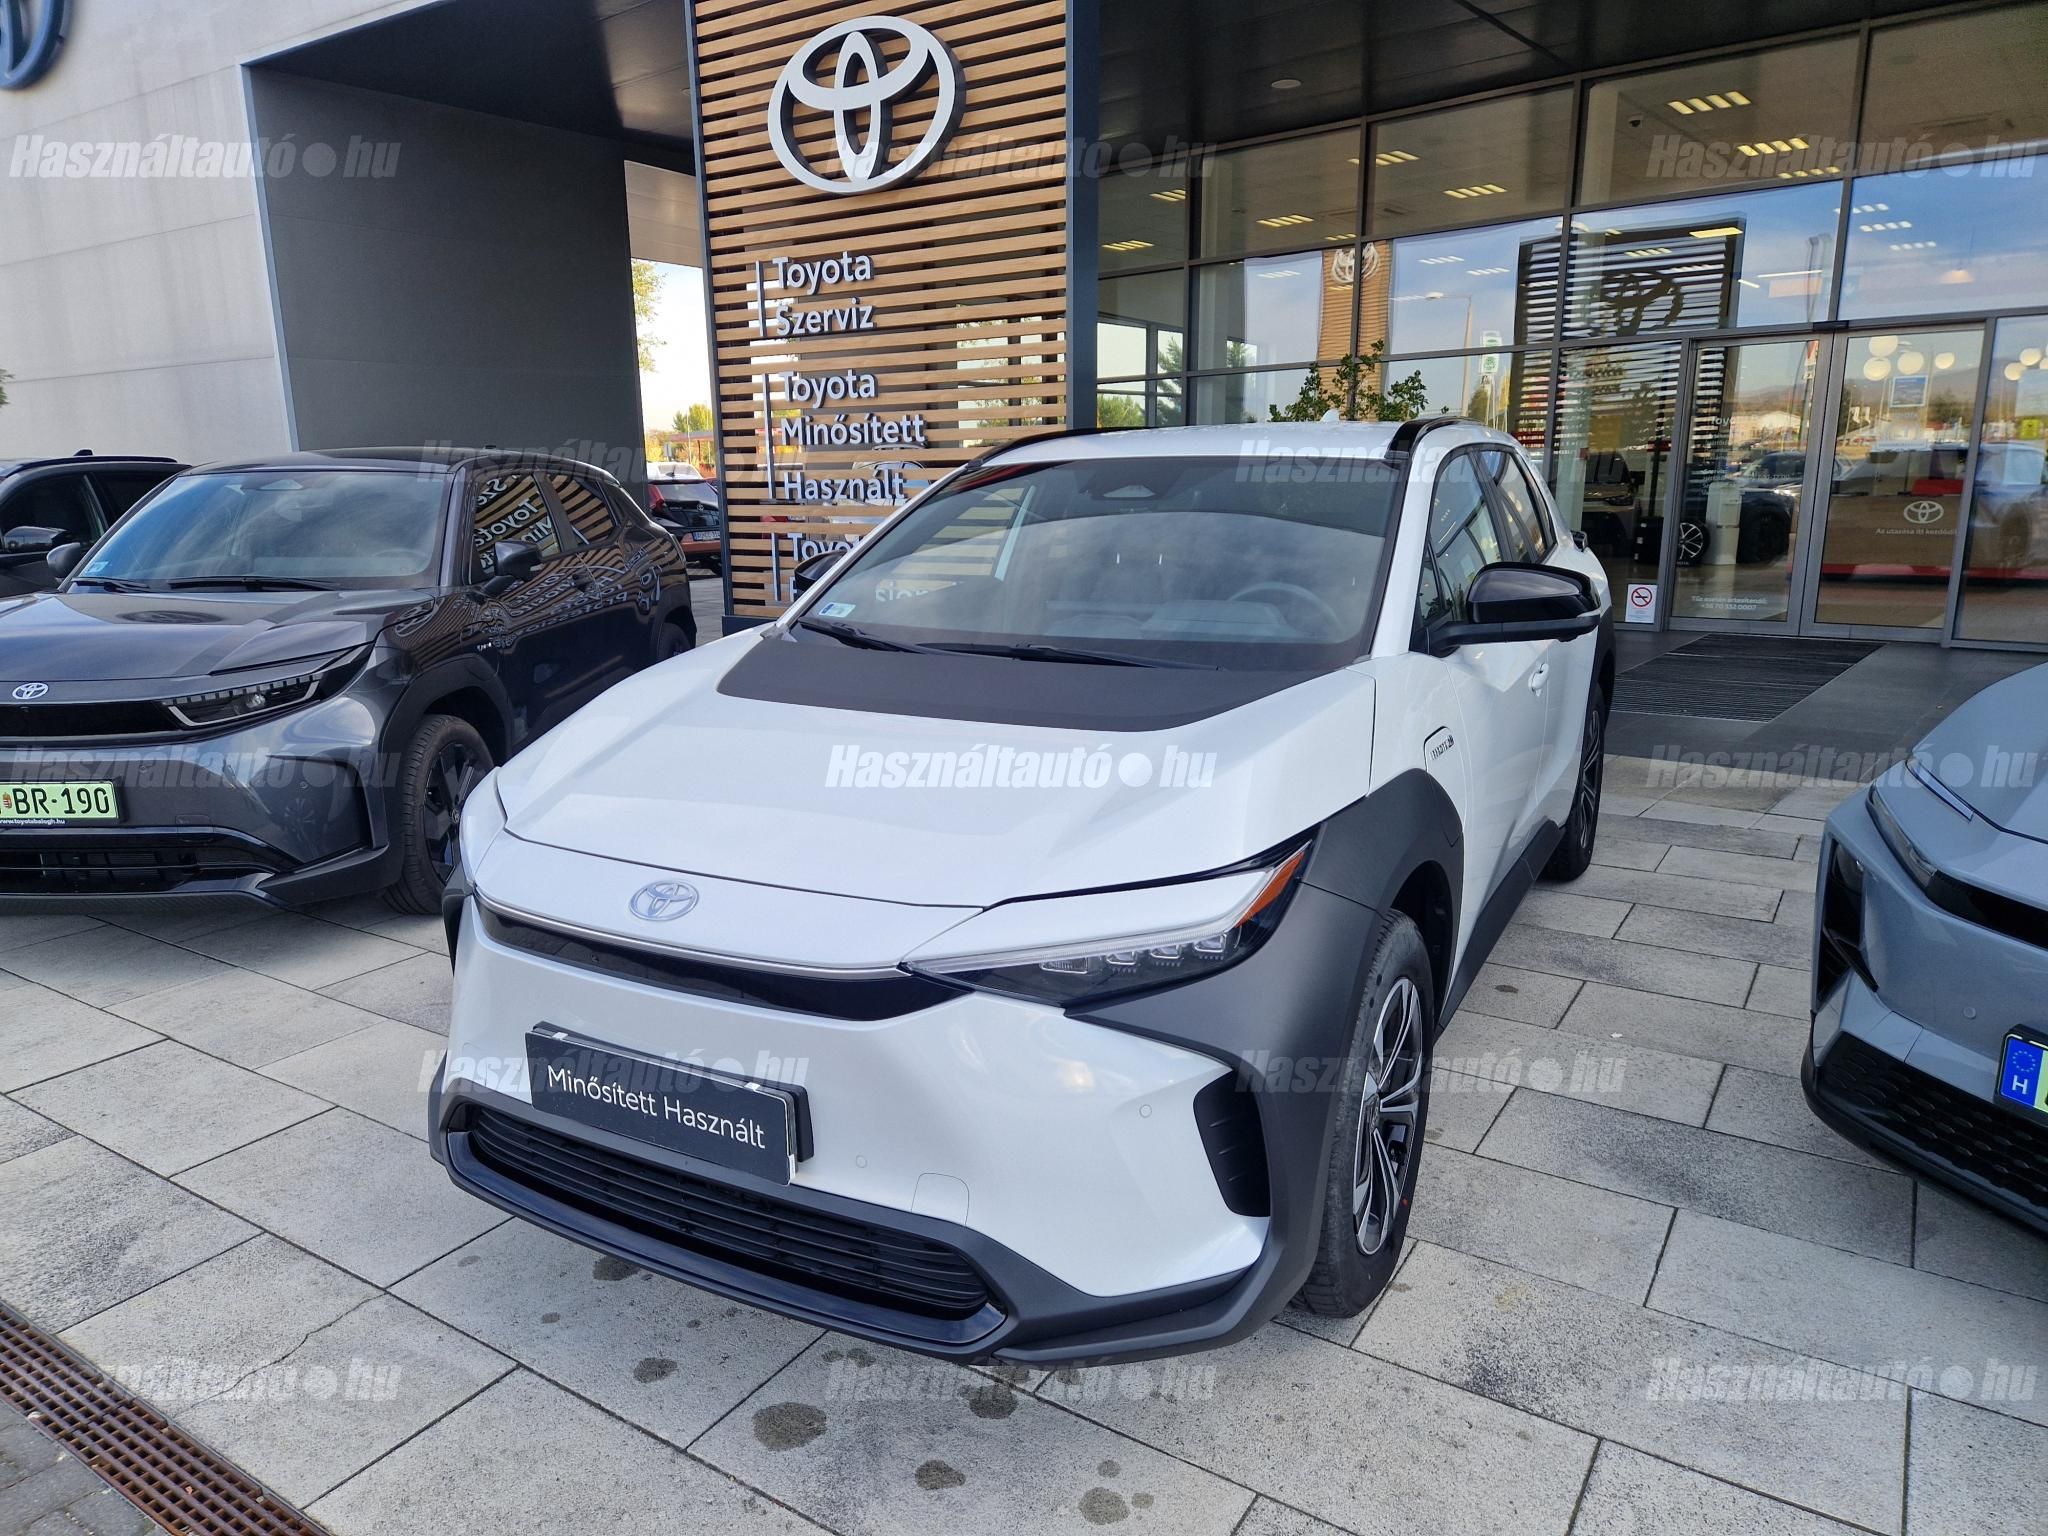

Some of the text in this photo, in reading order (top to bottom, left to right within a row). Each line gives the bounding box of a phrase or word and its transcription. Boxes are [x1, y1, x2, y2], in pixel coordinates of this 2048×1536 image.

[772, 251, 874, 295] Toyota
[776, 297, 876, 336] Szerviz
[779, 369, 878, 408] Toyota
[781, 414, 927, 446] Minősített
[784, 469, 906, 501] Használt
[2012, 1074, 2028, 1095] H
[547, 1064, 766, 1149] Minősített Használt
